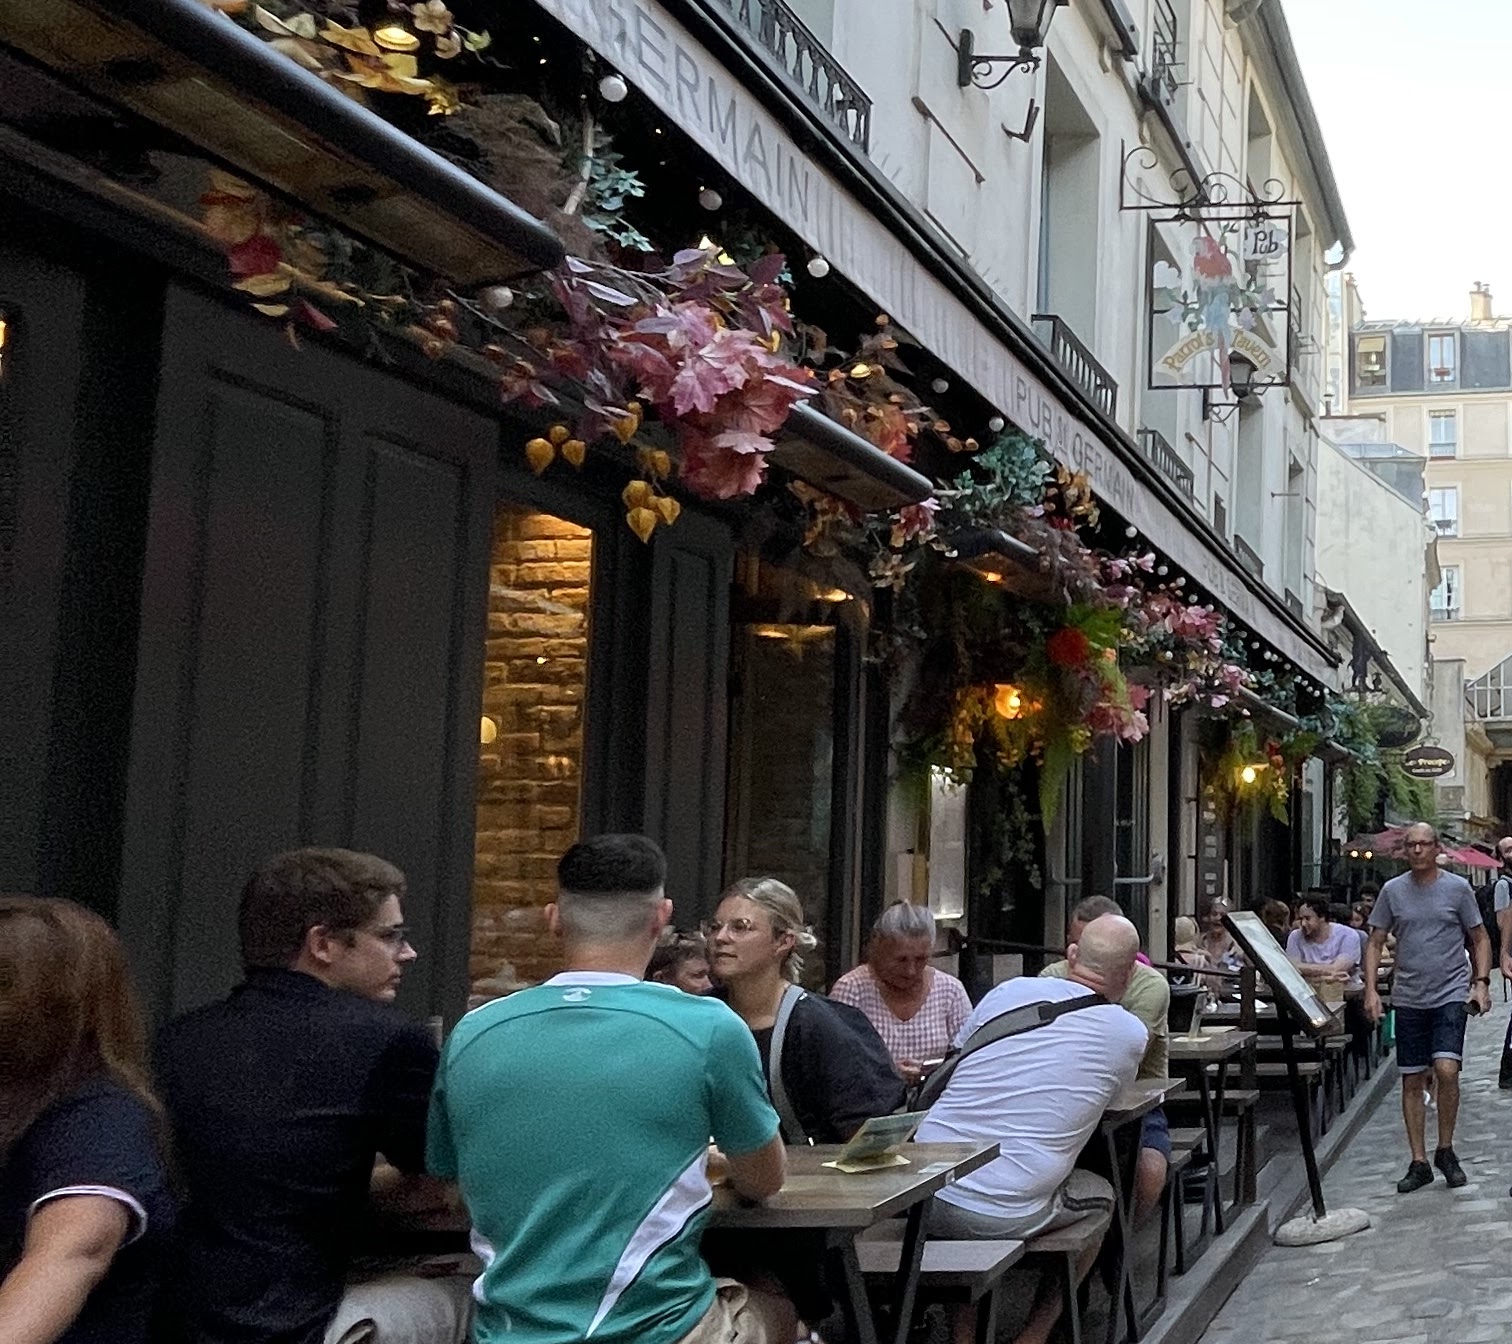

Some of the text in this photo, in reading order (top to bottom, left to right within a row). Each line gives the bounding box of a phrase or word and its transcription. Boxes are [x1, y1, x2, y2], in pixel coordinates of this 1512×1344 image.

[1252, 229, 1279, 255] Pub
[1162, 328, 1272, 372] Parrot's Tavern
[1016, 375, 1053, 440] PUB
